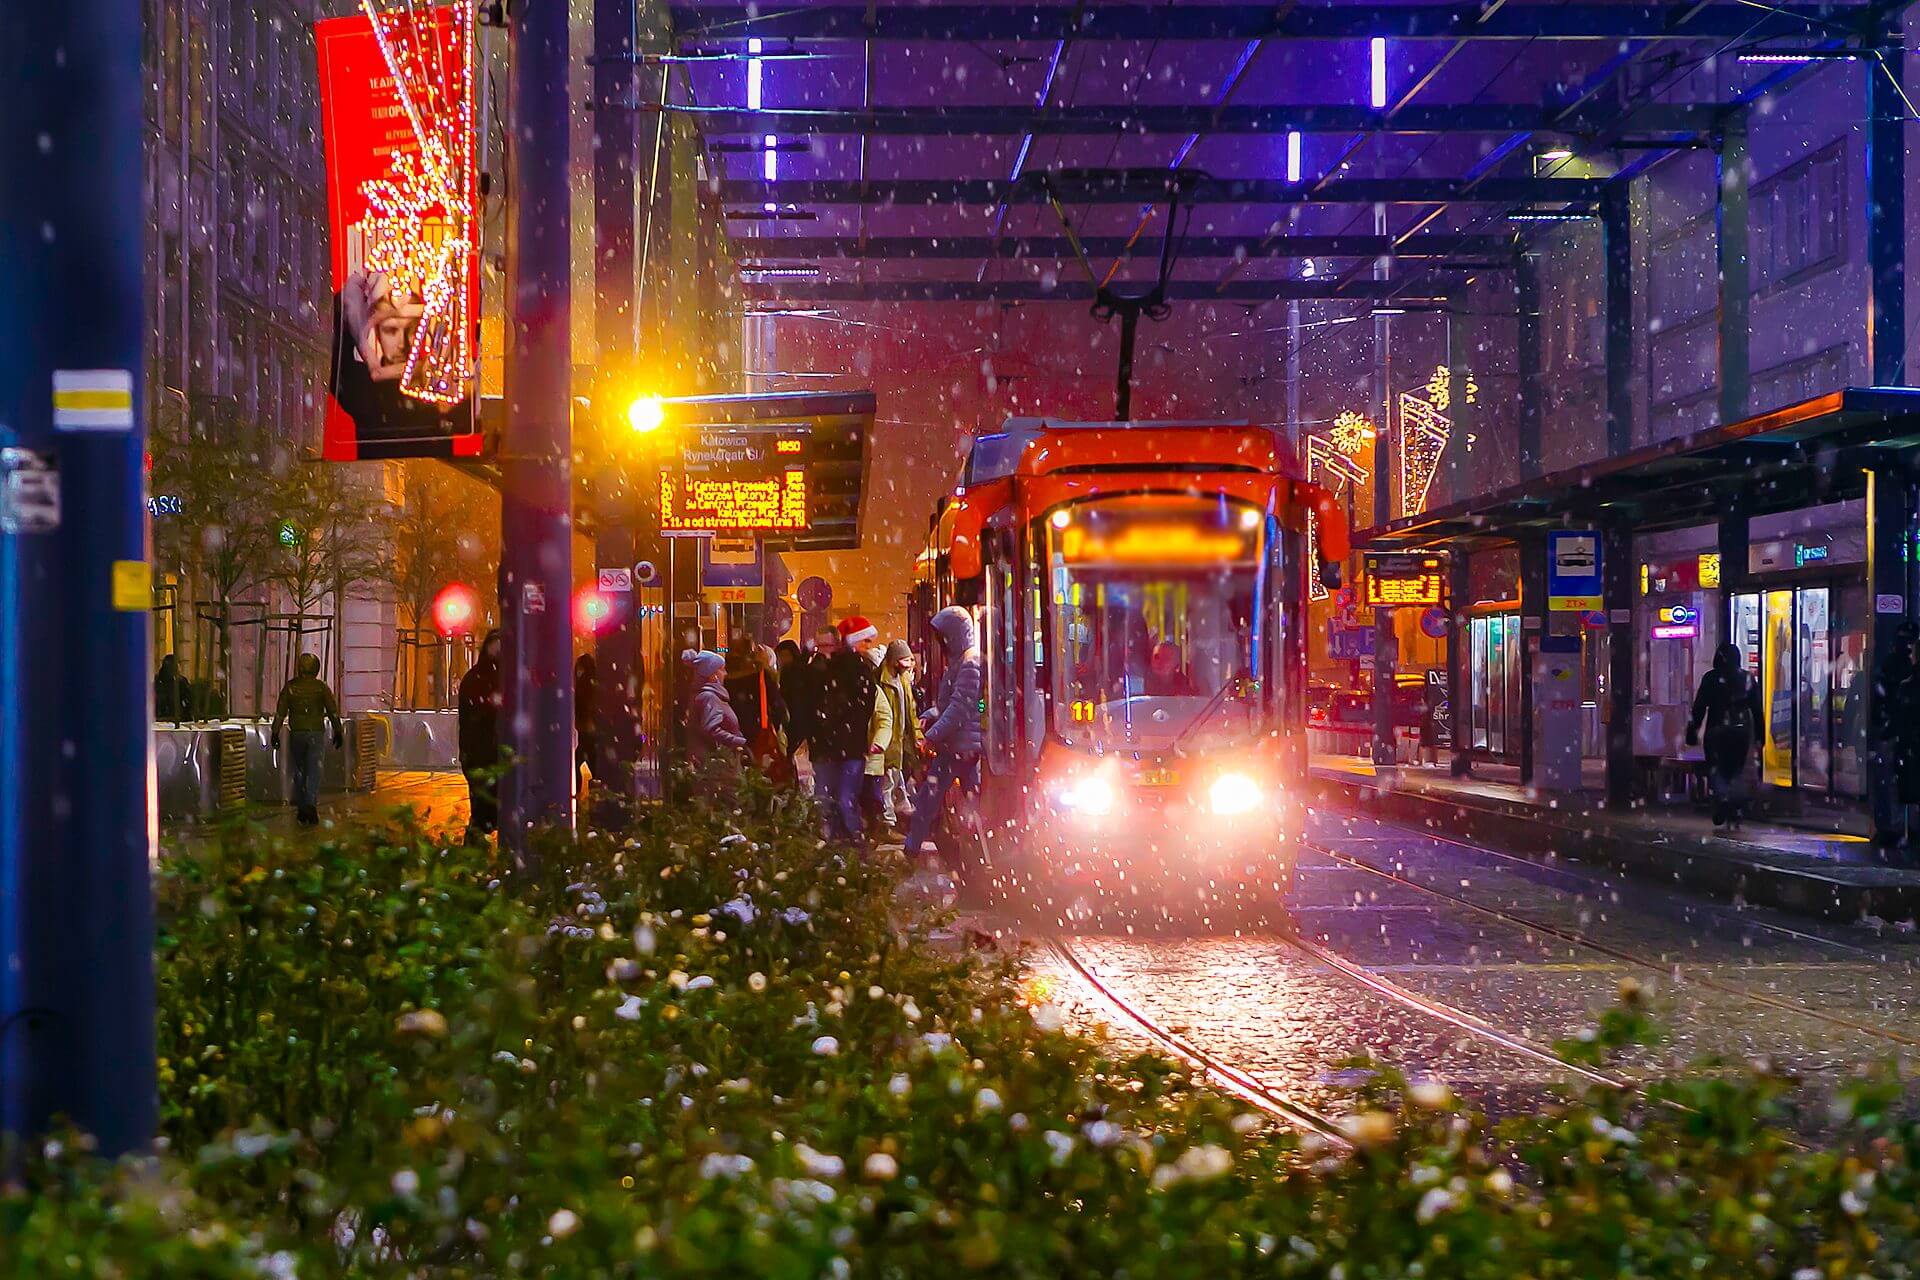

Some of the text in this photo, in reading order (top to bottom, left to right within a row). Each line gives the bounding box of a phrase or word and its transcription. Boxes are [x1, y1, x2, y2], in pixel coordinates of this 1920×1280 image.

[701, 435, 748, 446] Katowice
[720, 590, 746, 601] ZTM
[1072, 701, 1095, 721] 11
